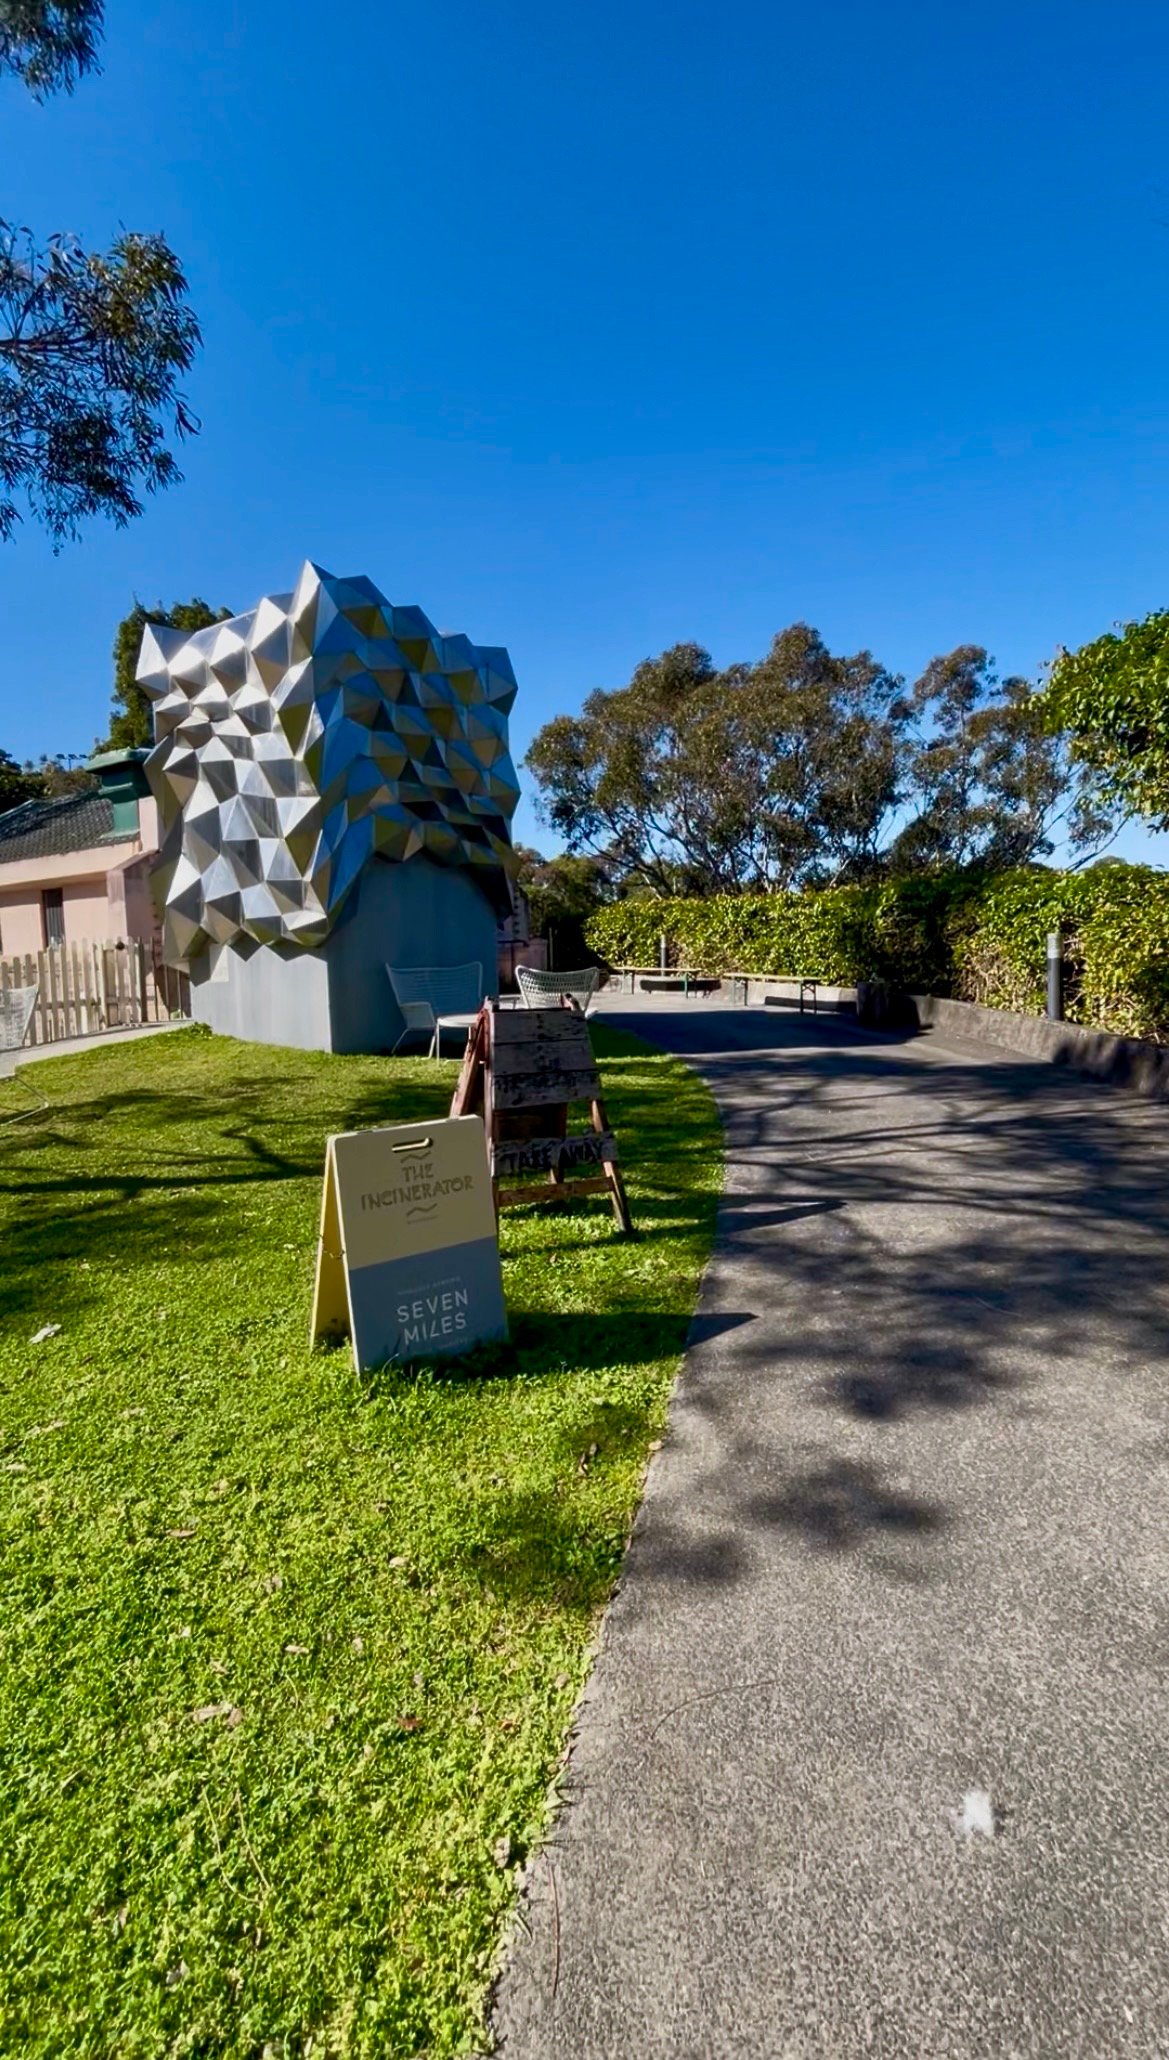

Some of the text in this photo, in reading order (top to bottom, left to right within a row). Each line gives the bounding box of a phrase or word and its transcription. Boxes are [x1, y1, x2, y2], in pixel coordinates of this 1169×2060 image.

[501, 1140, 603, 1171] TAKE AWAY
[402, 1163, 434, 1182] THE
[361, 1175, 474, 1210] INCINERATOR
[397, 1288, 468, 1322] SEVEN
[404, 1312, 466, 1345] MILES
